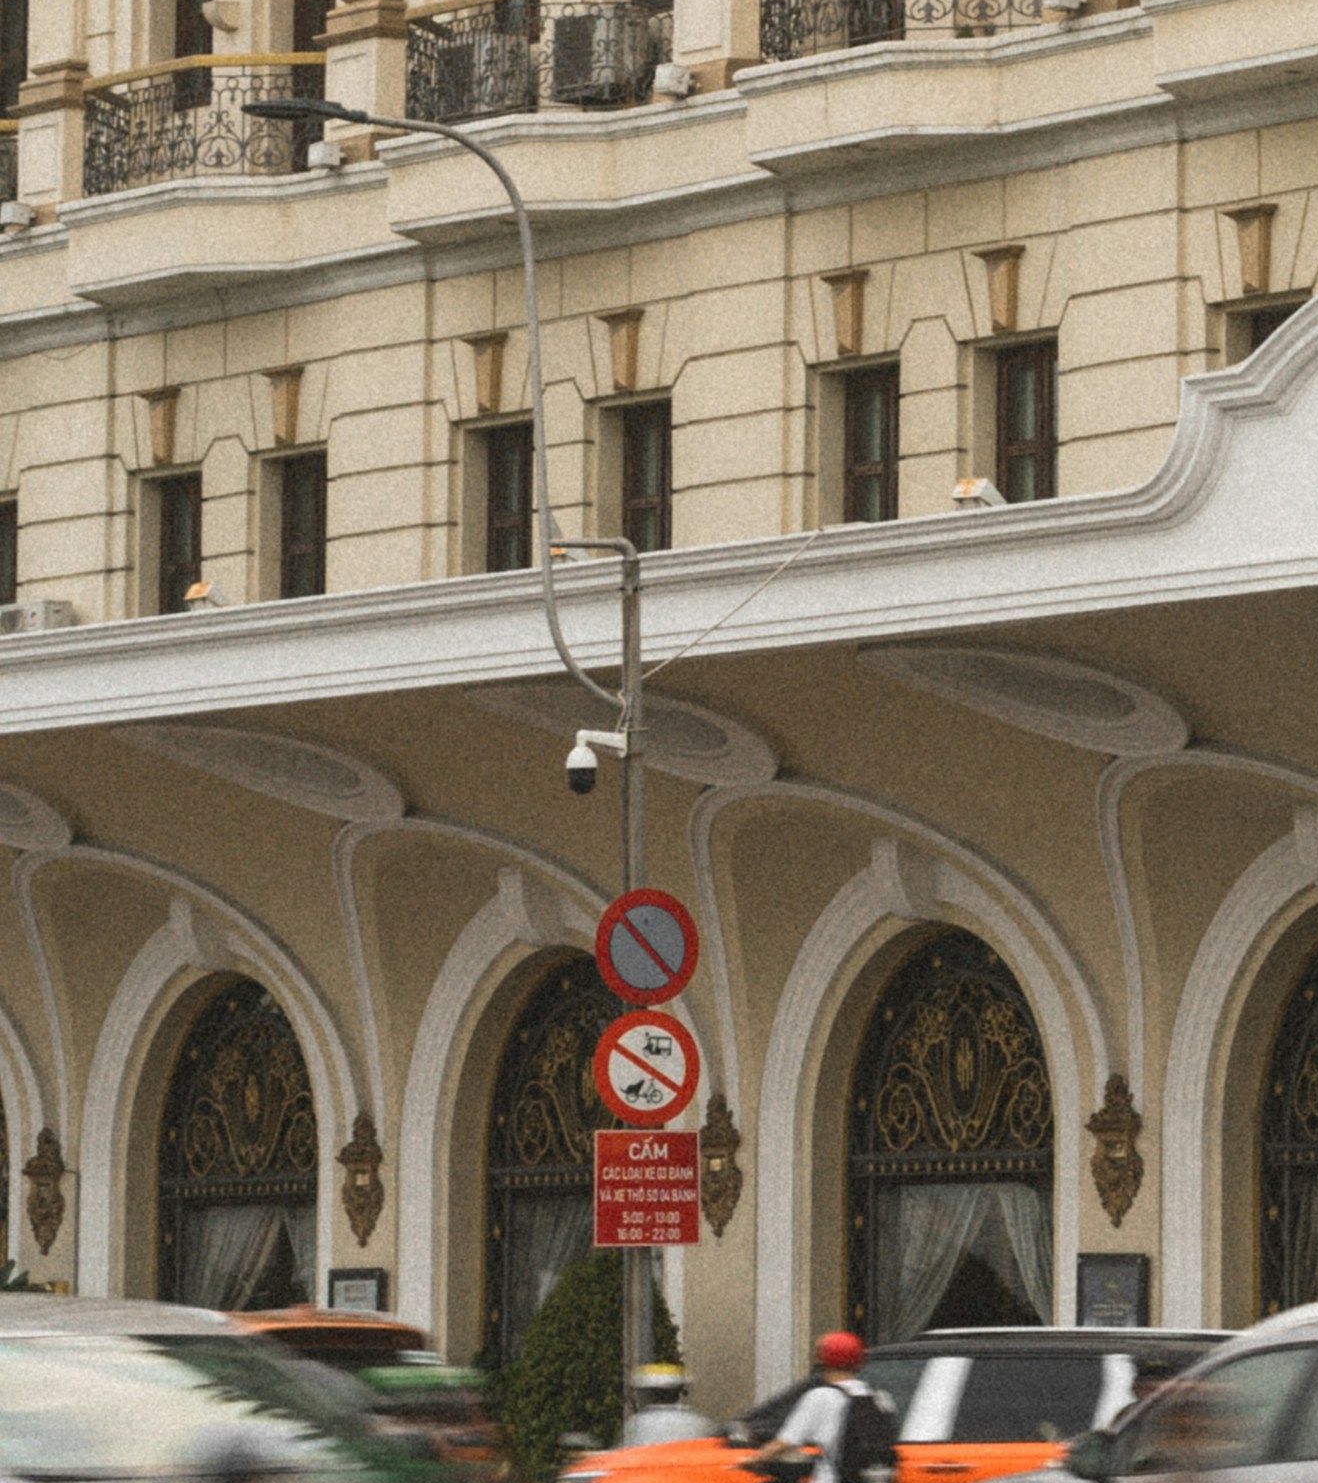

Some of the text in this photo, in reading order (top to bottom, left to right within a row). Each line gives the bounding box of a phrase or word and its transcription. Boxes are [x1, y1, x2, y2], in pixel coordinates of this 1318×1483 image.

[628, 1136, 669, 1160] CẤM
[644, 1166, 656, 1180] XE
[614, 1188, 625, 1202] XE
